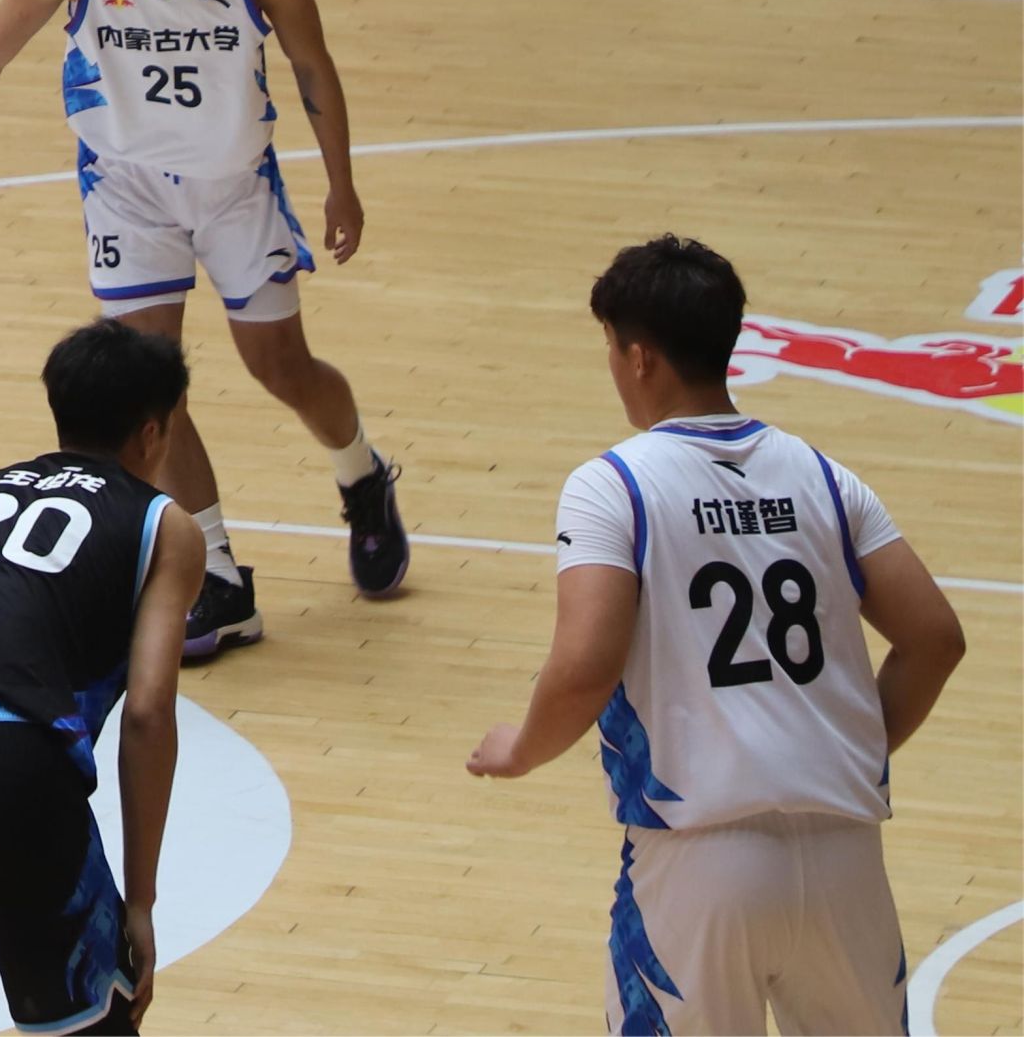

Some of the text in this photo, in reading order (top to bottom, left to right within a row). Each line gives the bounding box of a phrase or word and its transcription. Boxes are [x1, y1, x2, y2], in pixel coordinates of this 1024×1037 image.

[97, 25, 240, 52] 内蒙古大学
[142, 65, 203, 108] 25
[92, 235, 121, 268] 25
[692, 497, 797, 535] 付谨智
[689, 559, 825, 688] 28
